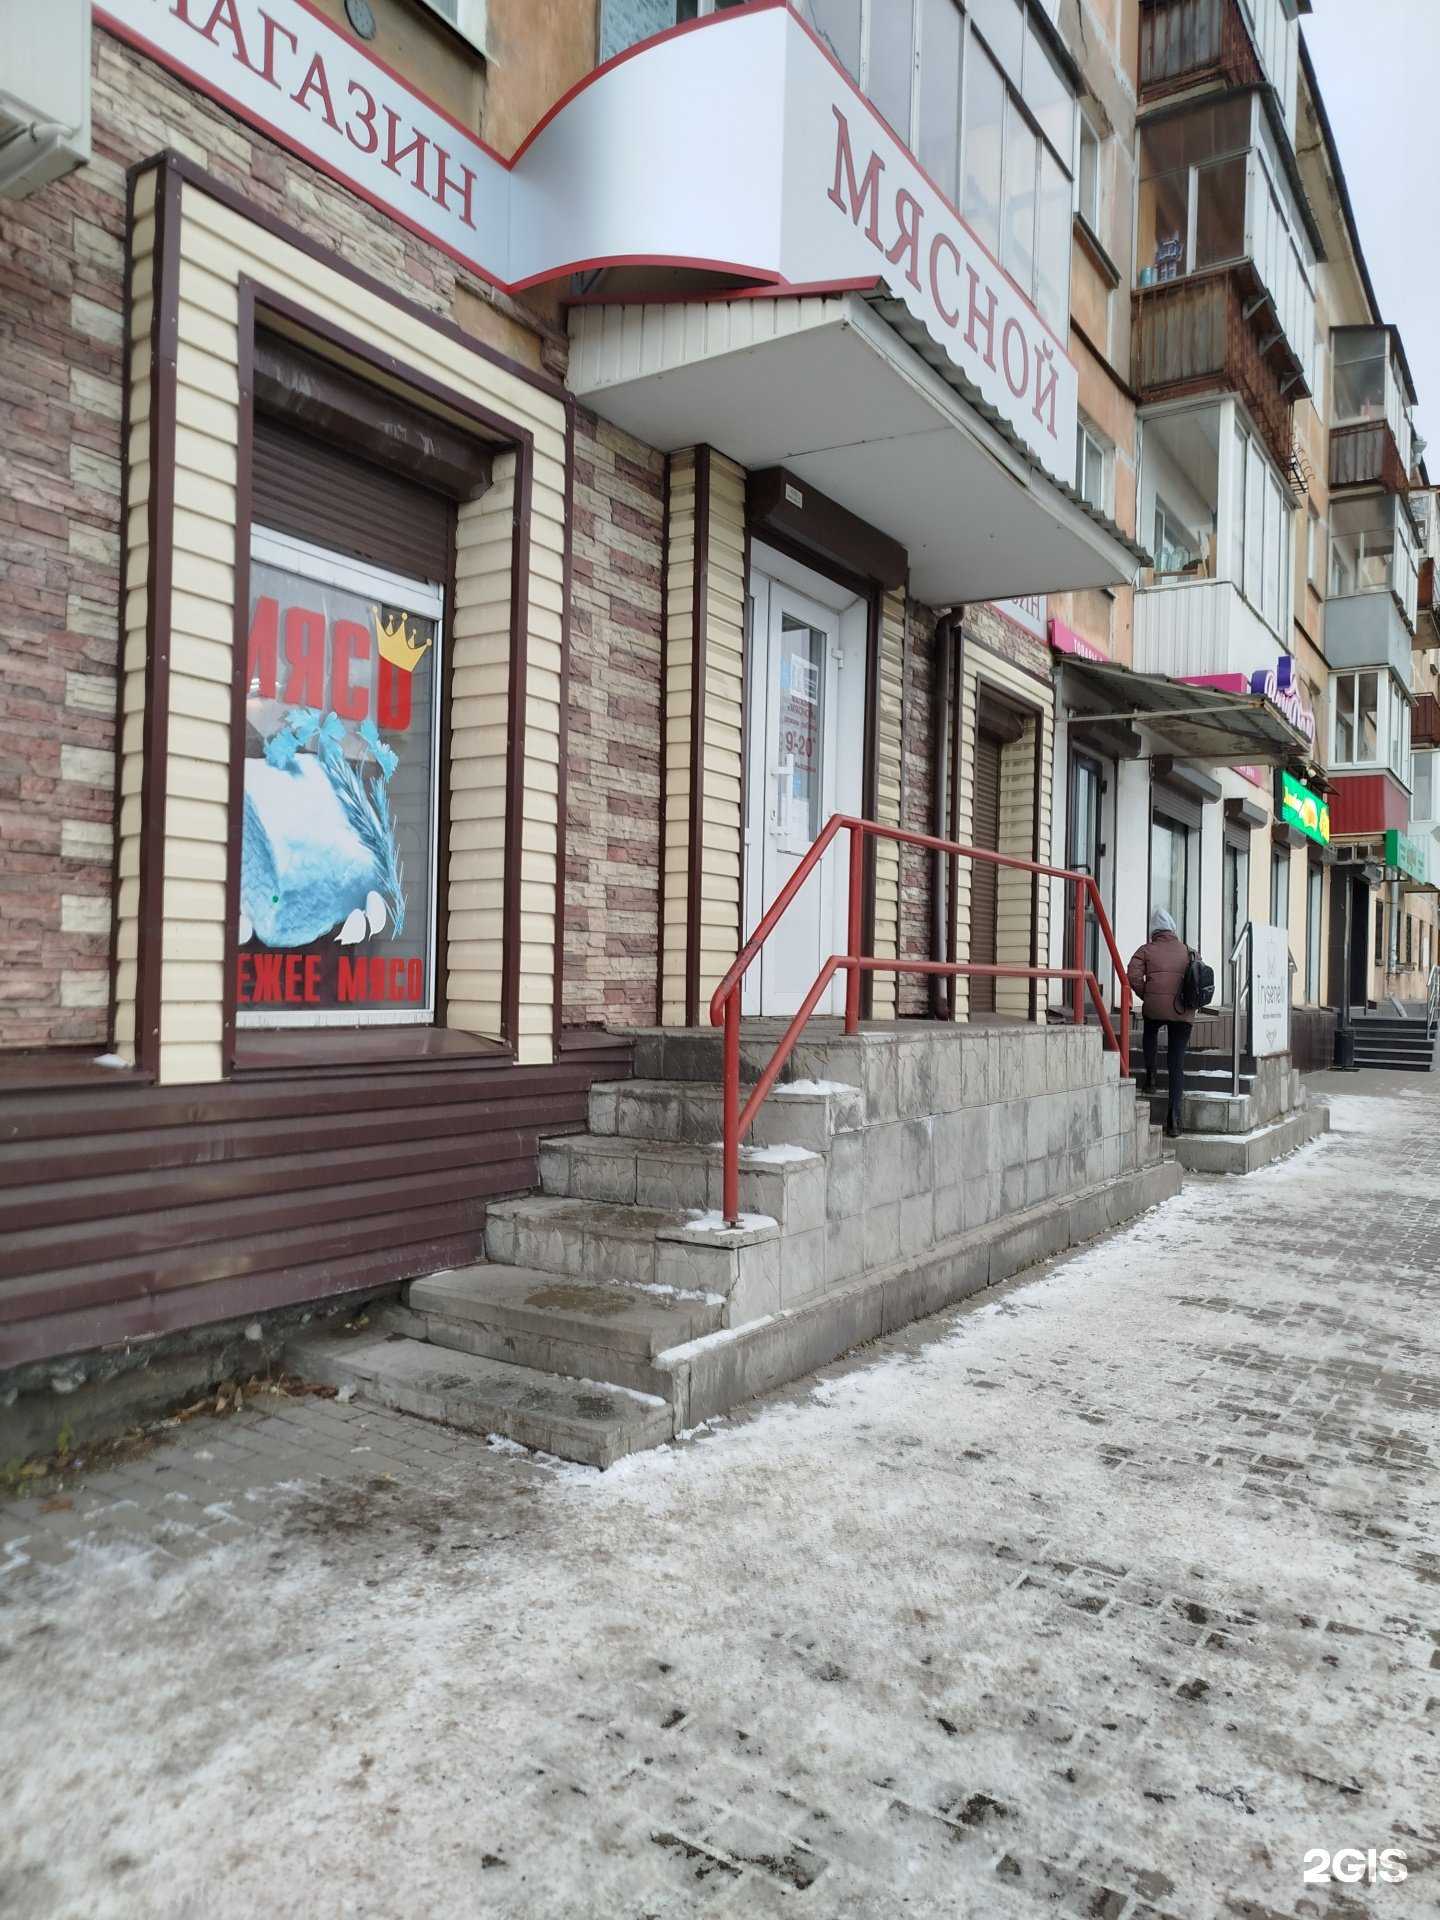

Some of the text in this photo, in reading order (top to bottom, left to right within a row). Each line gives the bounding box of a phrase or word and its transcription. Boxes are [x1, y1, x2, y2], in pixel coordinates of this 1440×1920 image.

[169, 0, 478, 231] АГАЗИН
[827, 103, 1060, 441] МЯСНОЙ
[337, 955, 423, 1003] МЯСО
